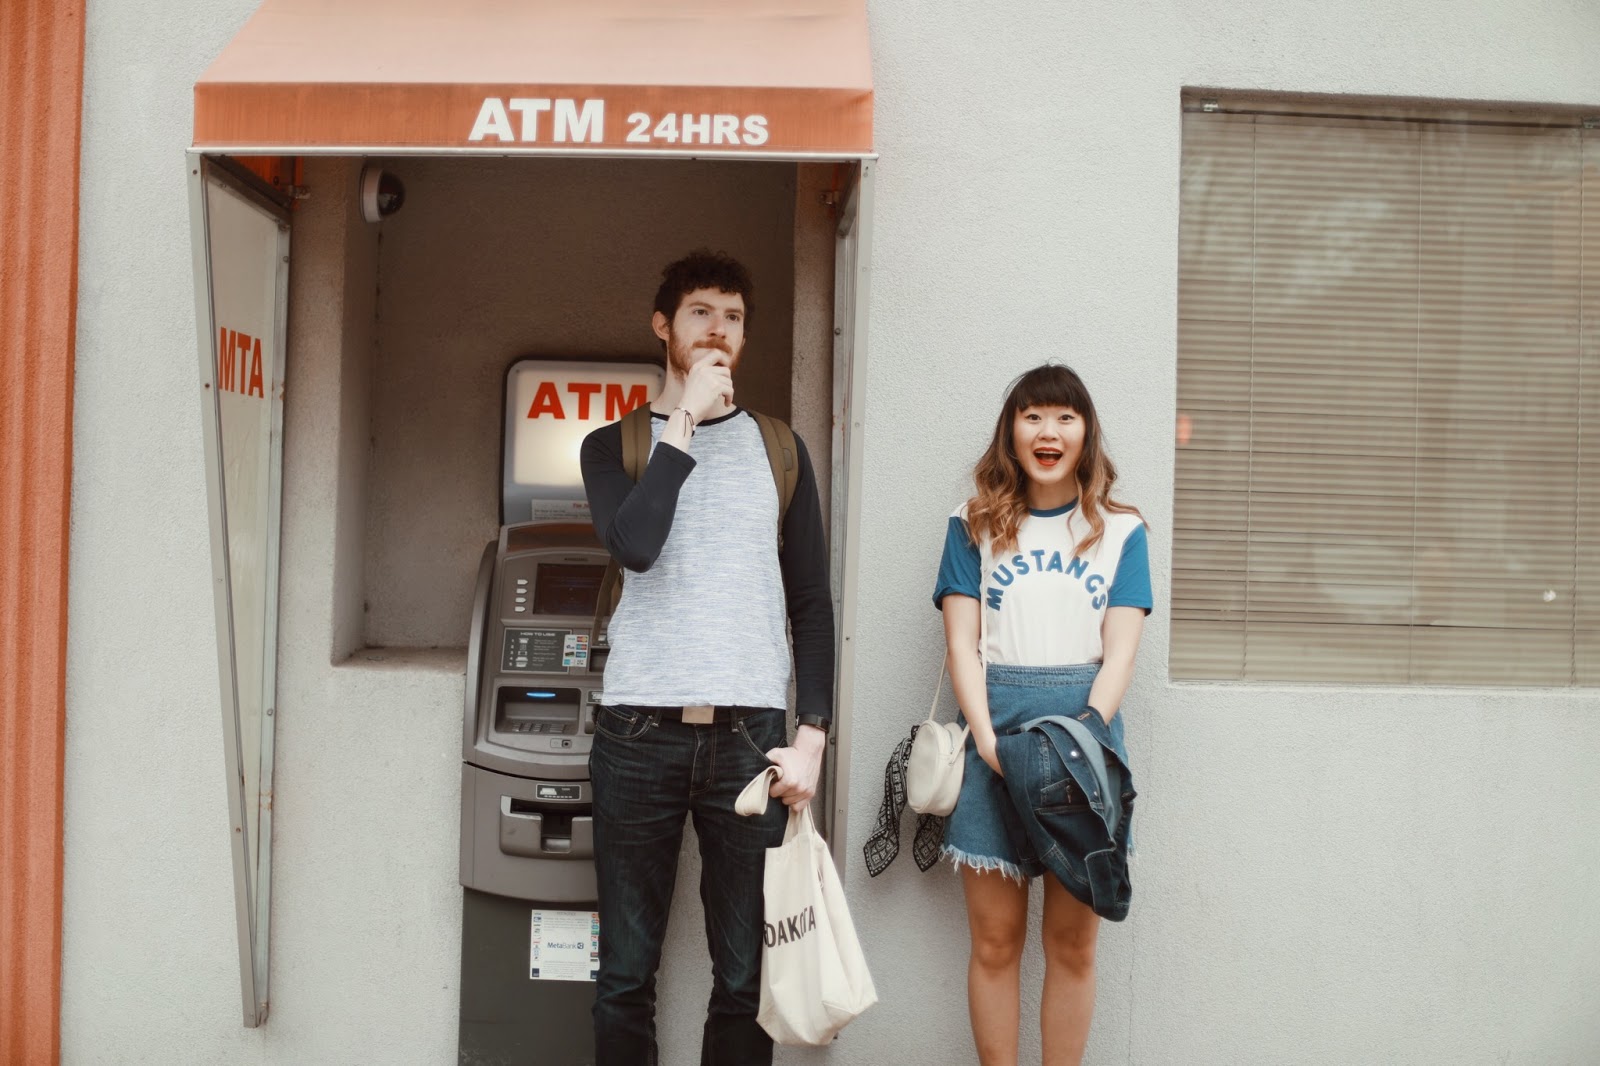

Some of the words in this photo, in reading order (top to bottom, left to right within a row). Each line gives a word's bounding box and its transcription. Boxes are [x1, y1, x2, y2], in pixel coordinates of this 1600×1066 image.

[468, 97, 604, 143] ATM
[626, 112, 769, 146] 24HRS
[527, 381, 647, 421] ATM
[986, 549, 1106, 611] MUSTANGS
